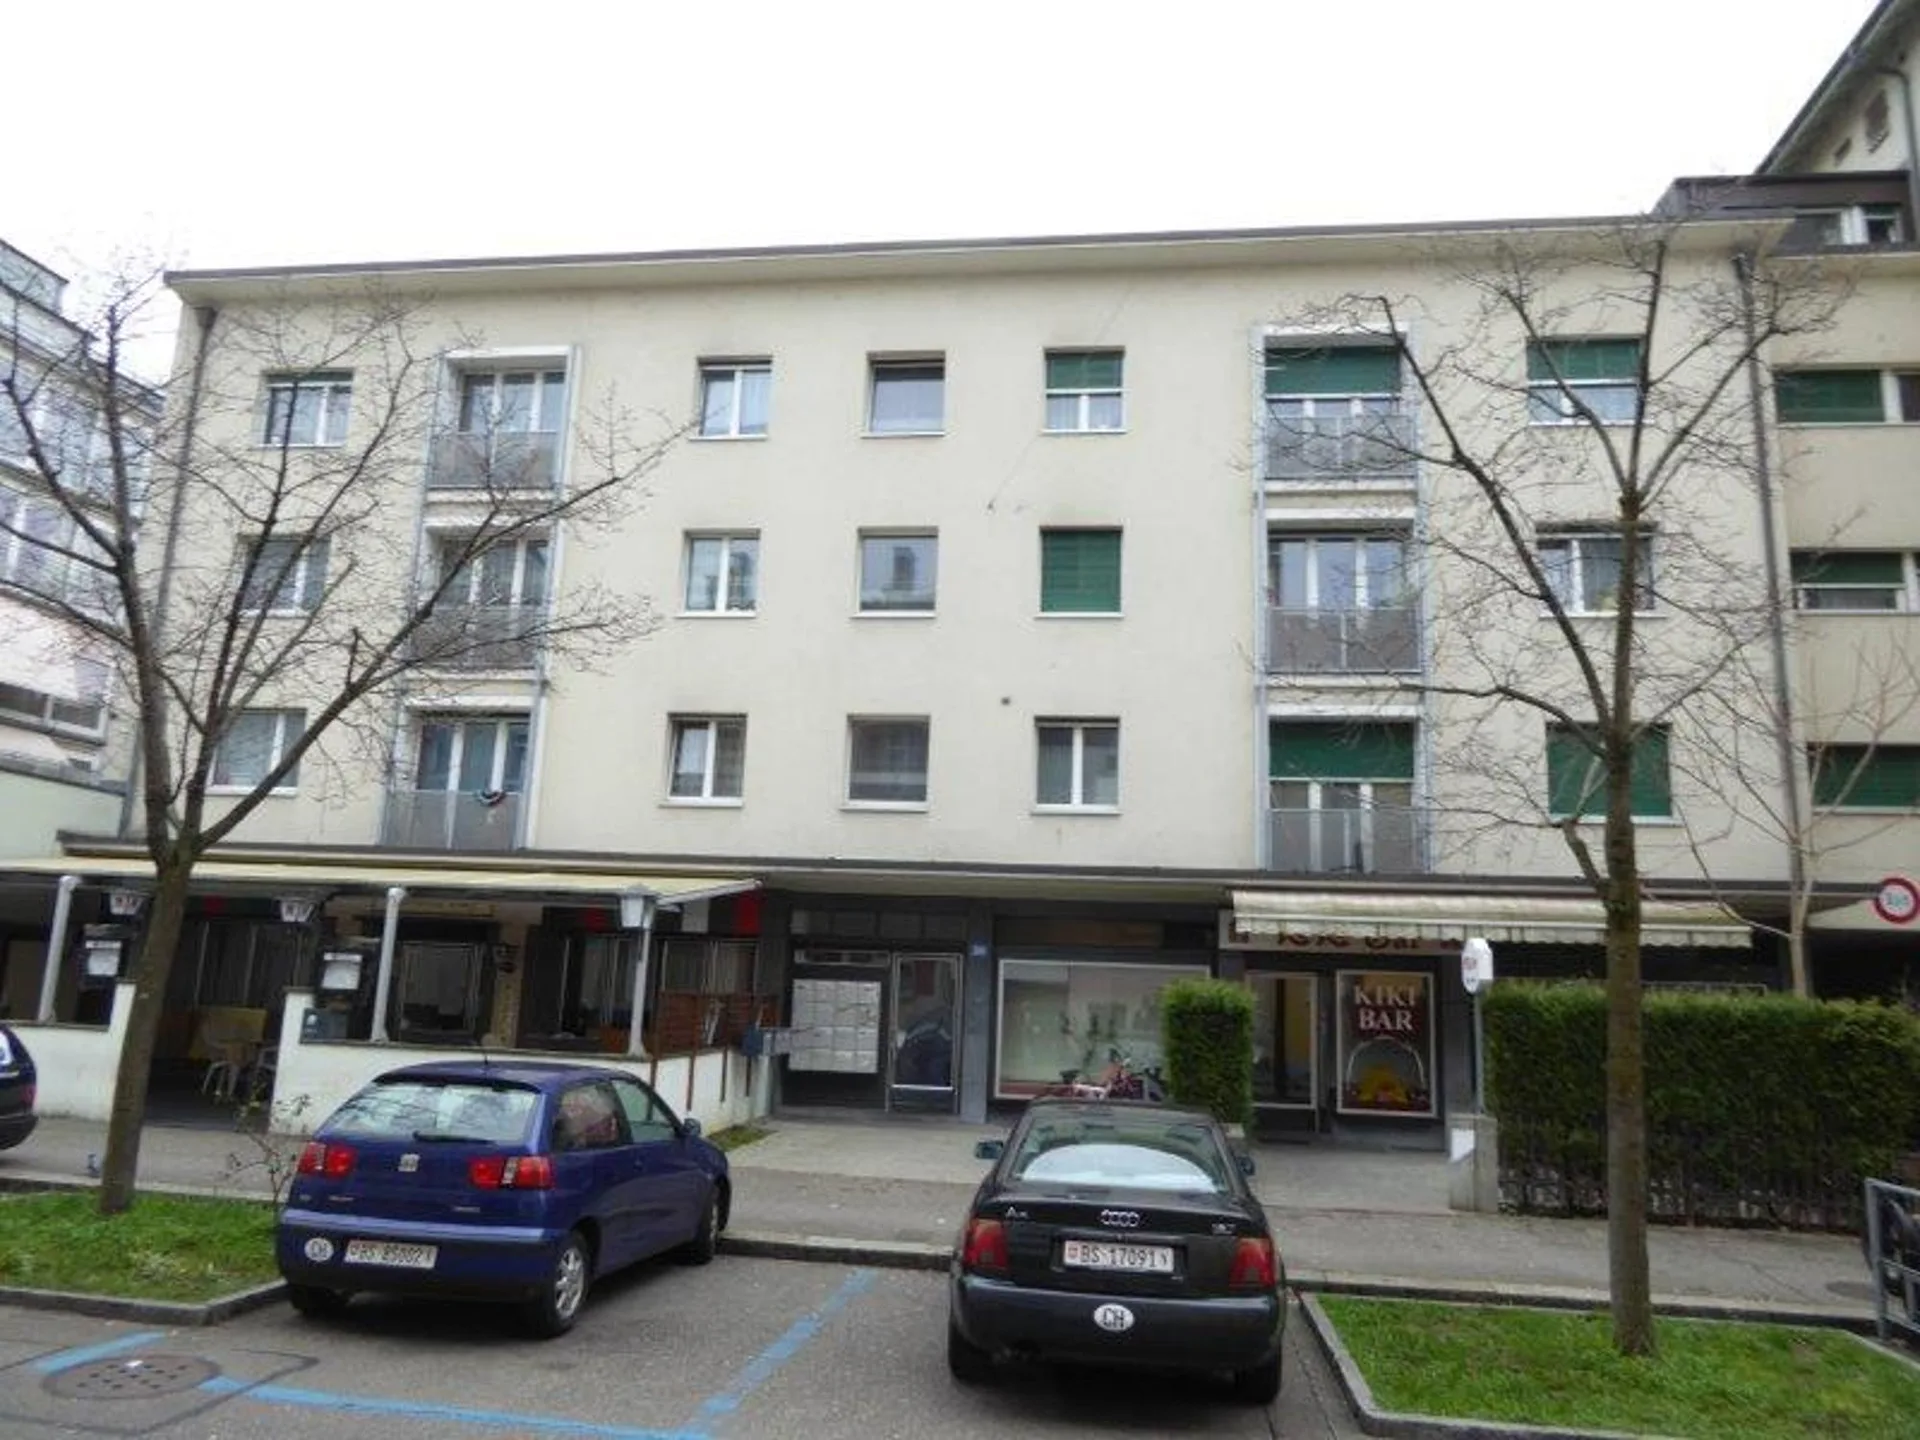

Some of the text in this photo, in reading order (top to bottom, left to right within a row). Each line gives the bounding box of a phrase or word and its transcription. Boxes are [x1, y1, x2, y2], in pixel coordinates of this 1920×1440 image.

[1354, 985, 1415, 1007] KIKI
[1359, 1007, 1413, 1031] BAR
[1081, 1244, 1157, 1268] BS 17091
[1103, 1307, 1125, 1328] CH
